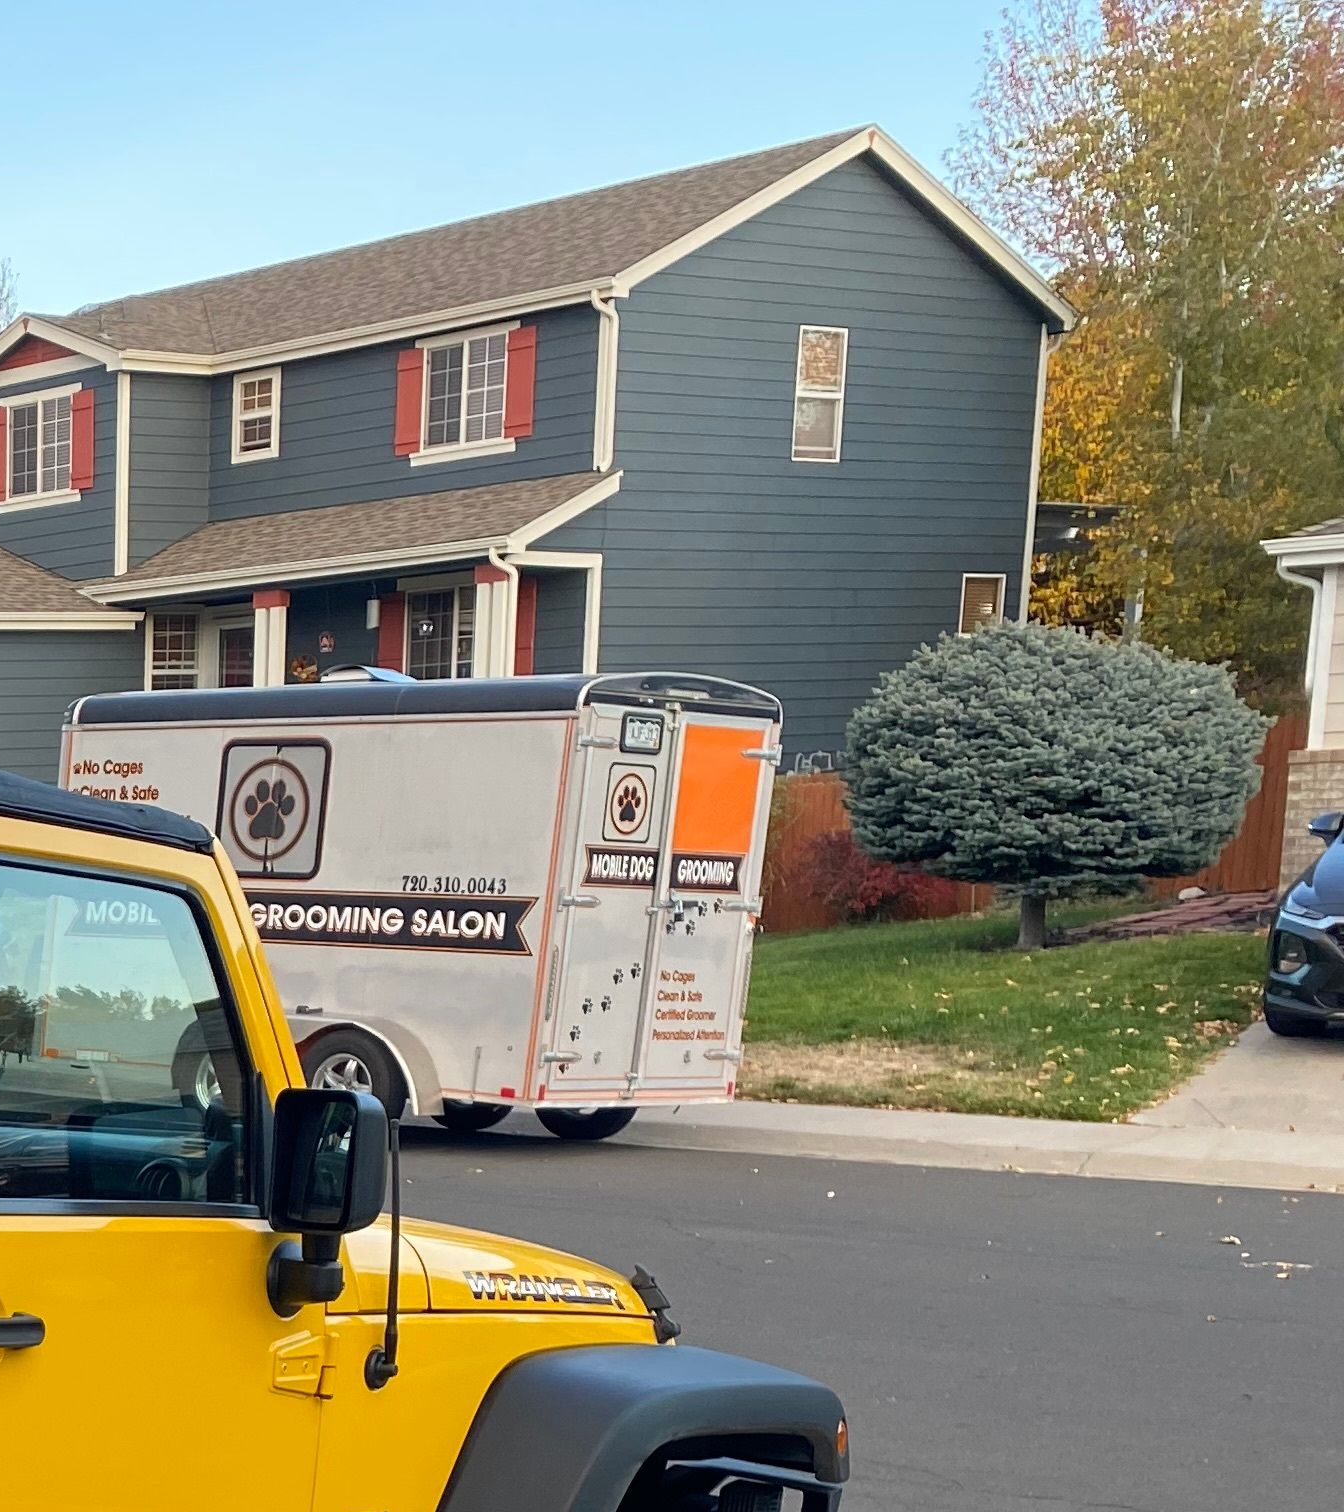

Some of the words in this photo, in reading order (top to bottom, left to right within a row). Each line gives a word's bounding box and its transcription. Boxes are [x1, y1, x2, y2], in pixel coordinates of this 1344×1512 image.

[82, 760, 100, 774] No
[103, 759, 144, 778] Cages
[80, 785, 116, 800] Clean
[119, 785, 129, 800] &
[131, 784, 160, 801] Safe
[591, 854, 628, 879] MOBILE
[629, 856, 655, 881] DOG
[677, 859, 735, 885] GROOMING
[401, 875, 507, 894] 720.310.0043
[249, 903, 405, 935] GROOMING
[411, 907, 507, 940] SALON
[660, 970, 671, 981] No
[672, 970, 696, 984] Cages
[657, 990, 679, 1001] Clean
[680, 990, 686, 1001] &
[687, 990, 703, 1002] Safe
[655, 1009, 686, 1020] Certified
[686, 1009, 716, 1020] Groomer
[652, 1029, 695, 1040] Personalized
[696, 1029, 725, 1040] Attention
[462, 1271, 626, 1311] WRANGLER
